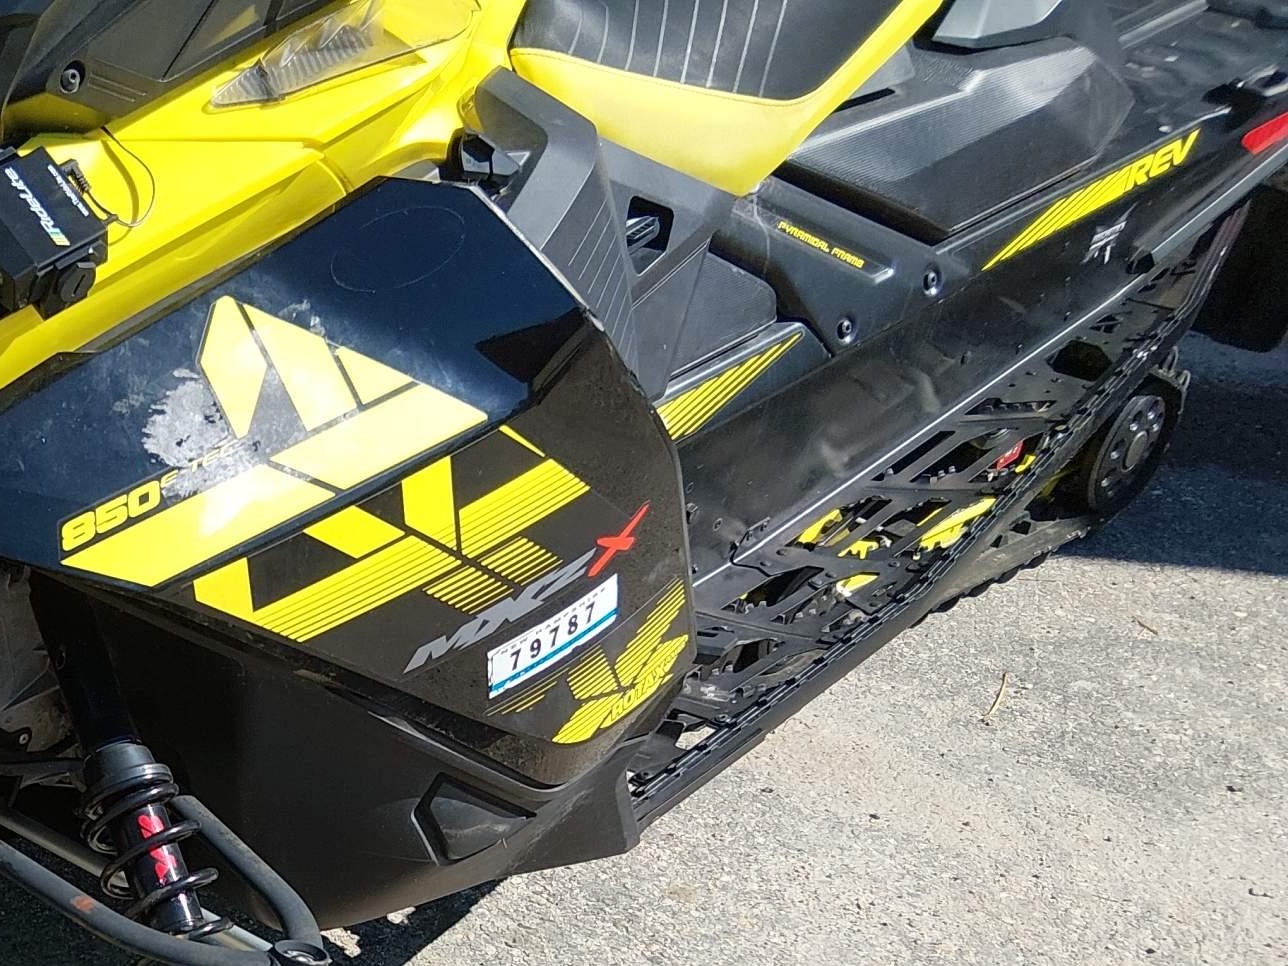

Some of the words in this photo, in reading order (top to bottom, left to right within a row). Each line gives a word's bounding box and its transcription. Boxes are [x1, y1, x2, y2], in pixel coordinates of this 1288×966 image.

[1125, 128, 1202, 191] REV
[4, 166, 61, 237] RideLite
[61, 480, 162, 552] 850
[509, 602, 596, 671] 79787
[610, 665, 666, 721] ROTAX
